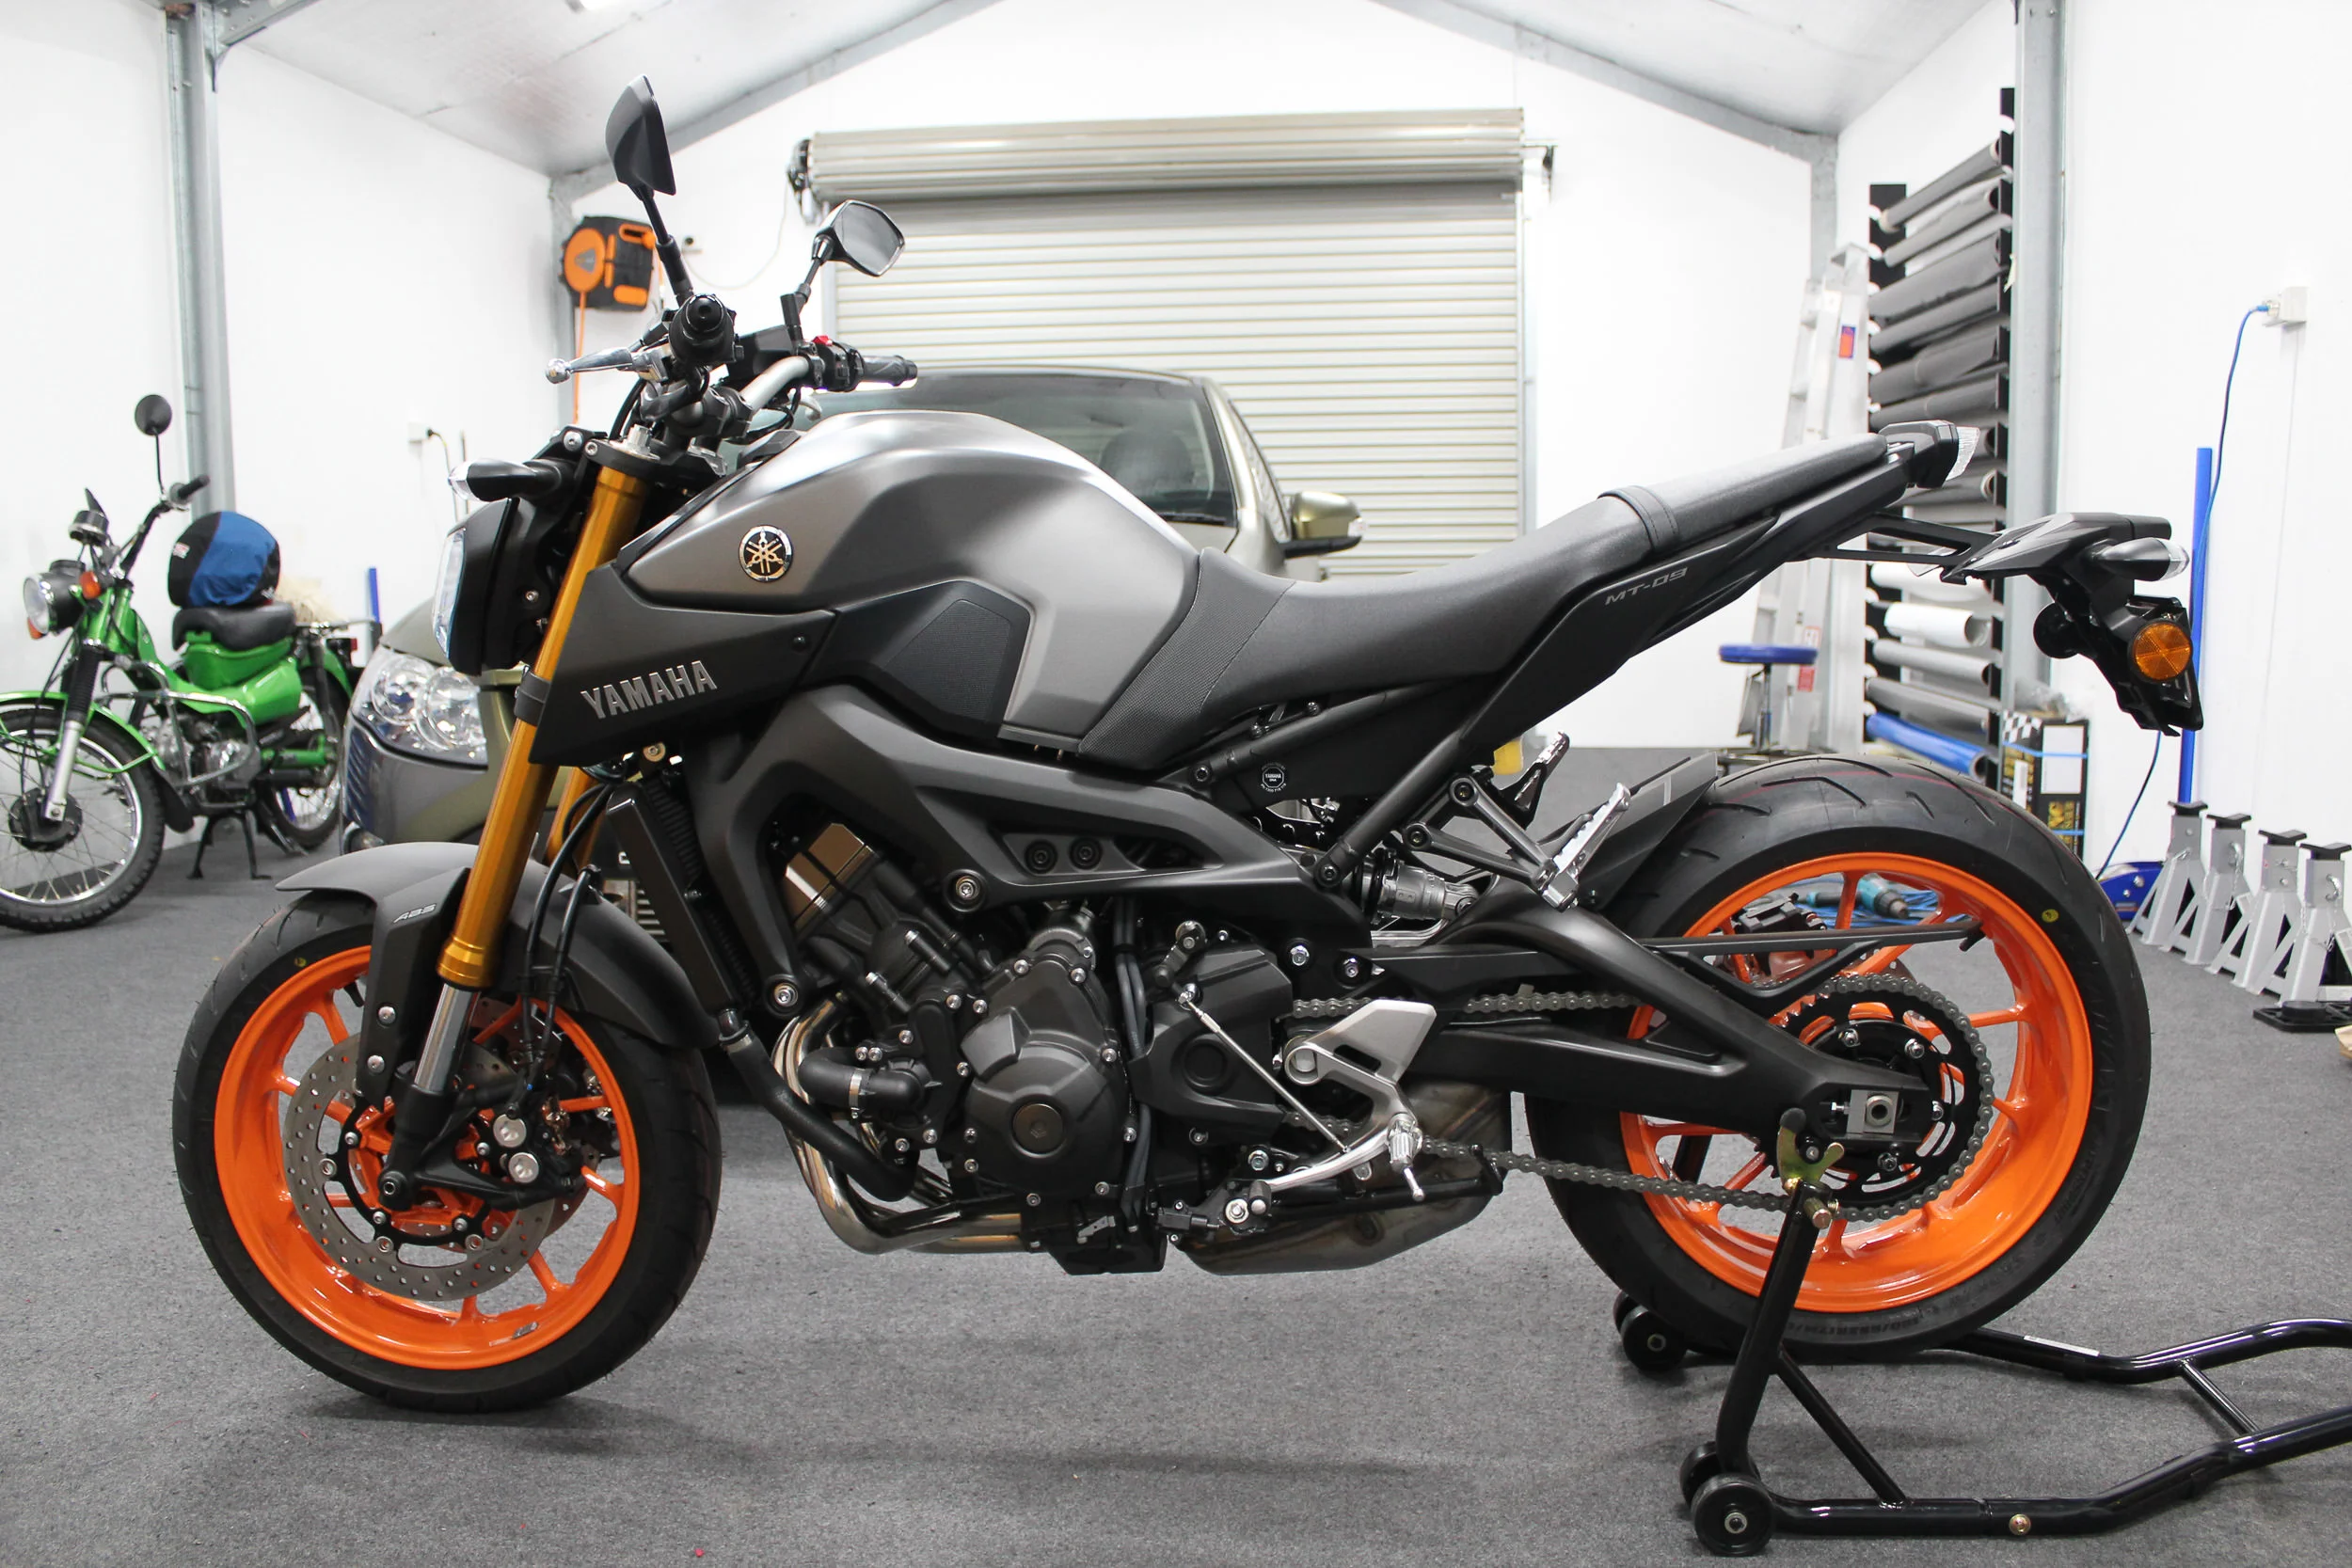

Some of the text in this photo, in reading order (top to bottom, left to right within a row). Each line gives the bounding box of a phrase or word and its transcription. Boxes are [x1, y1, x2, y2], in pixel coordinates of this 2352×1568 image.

[1605, 566, 1688, 606] MT-09
[580, 660, 718, 719] YAMAHA
[393, 903, 437, 924] ABS
